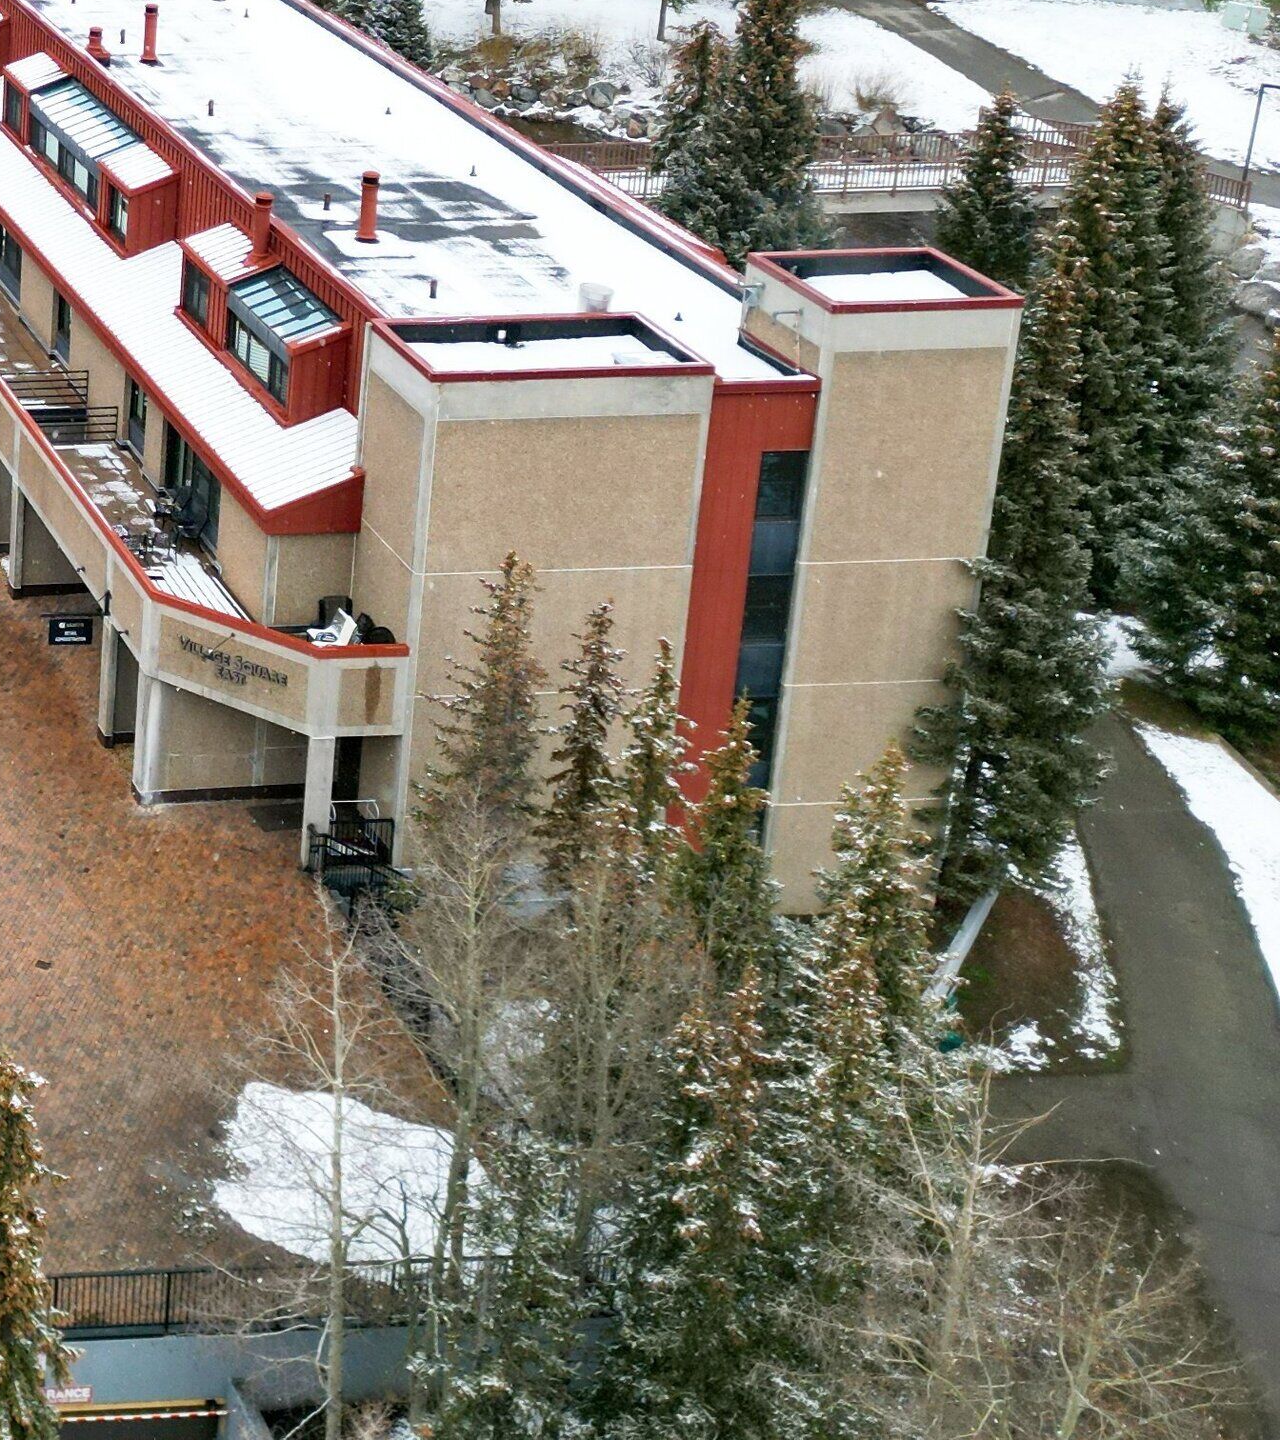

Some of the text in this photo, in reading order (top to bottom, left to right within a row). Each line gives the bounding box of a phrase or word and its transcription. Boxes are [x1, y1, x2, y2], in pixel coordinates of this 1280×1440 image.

[216, 665, 247, 686] EAST
[234, 654, 289, 688] SQUARE
[47, 1388, 91, 1400] RANCE
